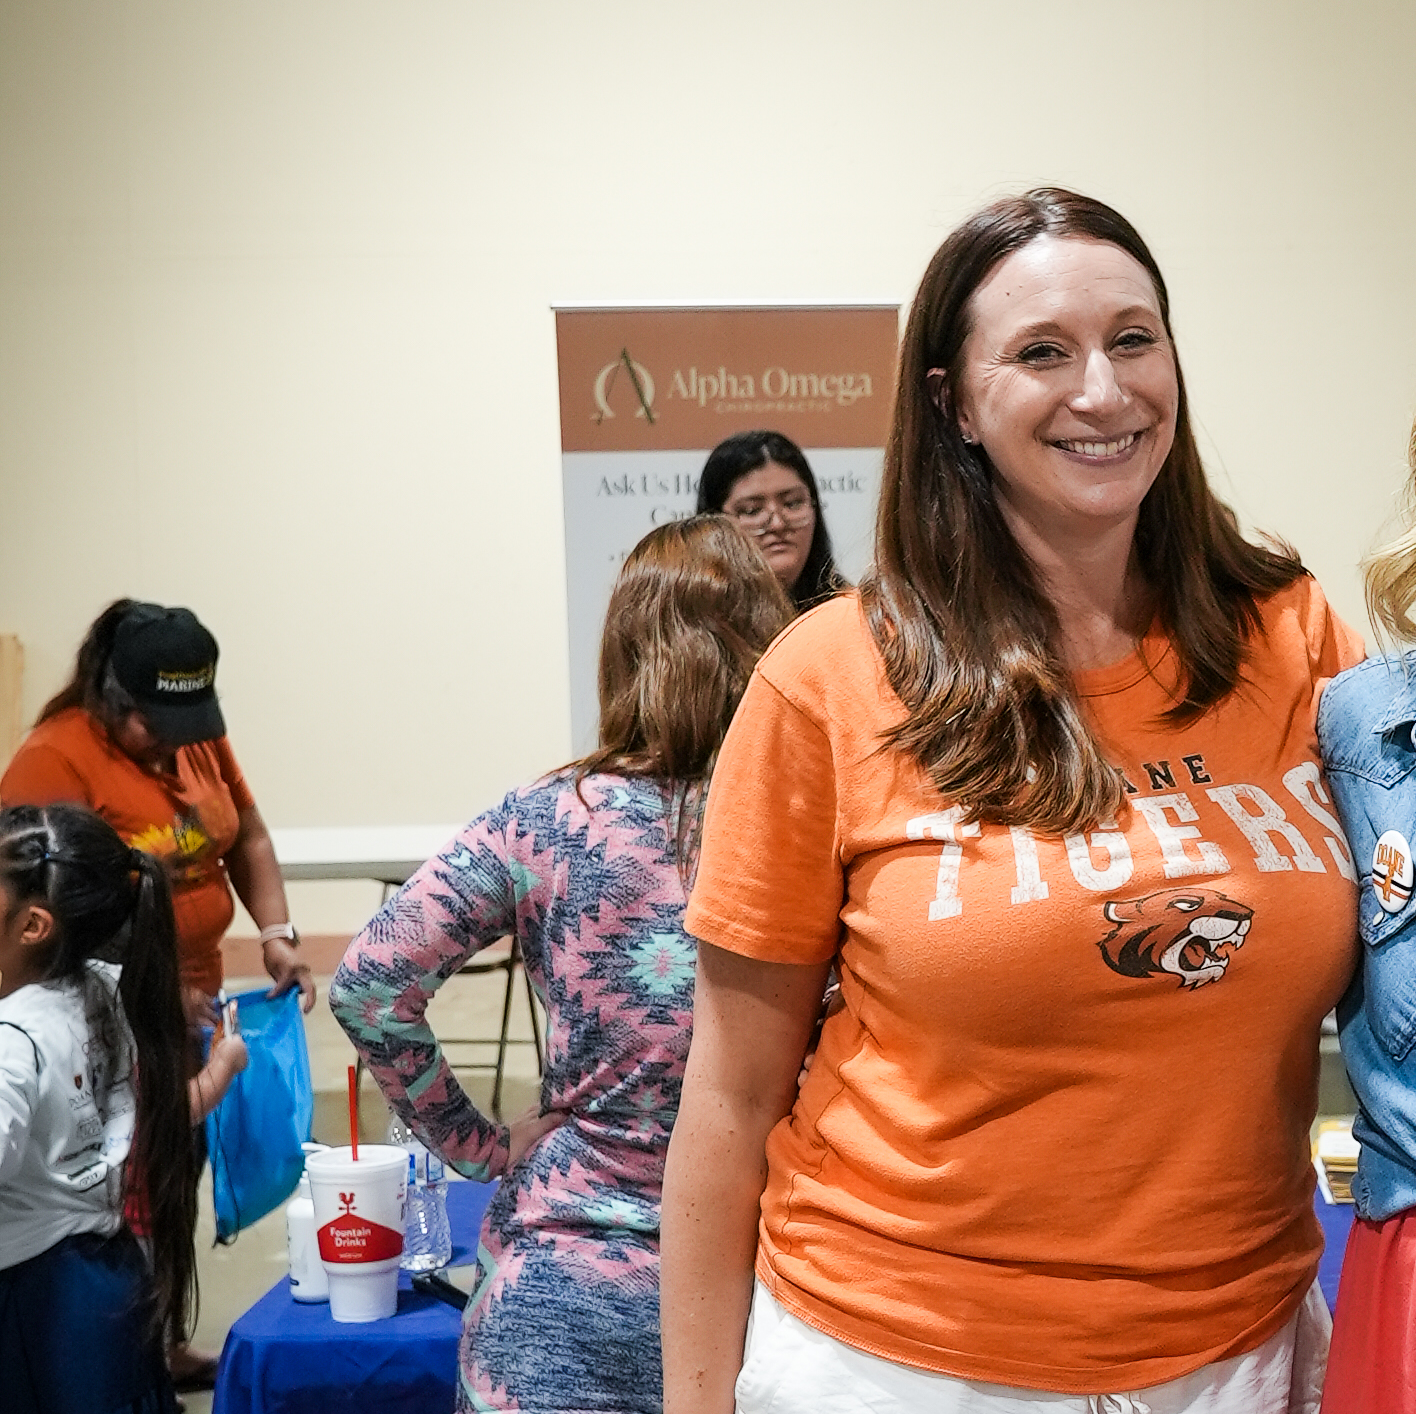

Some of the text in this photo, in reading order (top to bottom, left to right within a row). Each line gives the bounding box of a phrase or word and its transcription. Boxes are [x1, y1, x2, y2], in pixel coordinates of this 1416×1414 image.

[668, 366, 872, 407] Alpha Omega
[599, 473, 635, 496] Ask
[641, 474, 669, 495] Us
[330, 1227, 372, 1237] Fountain
[335, 1238, 367, 1248] Drinks
